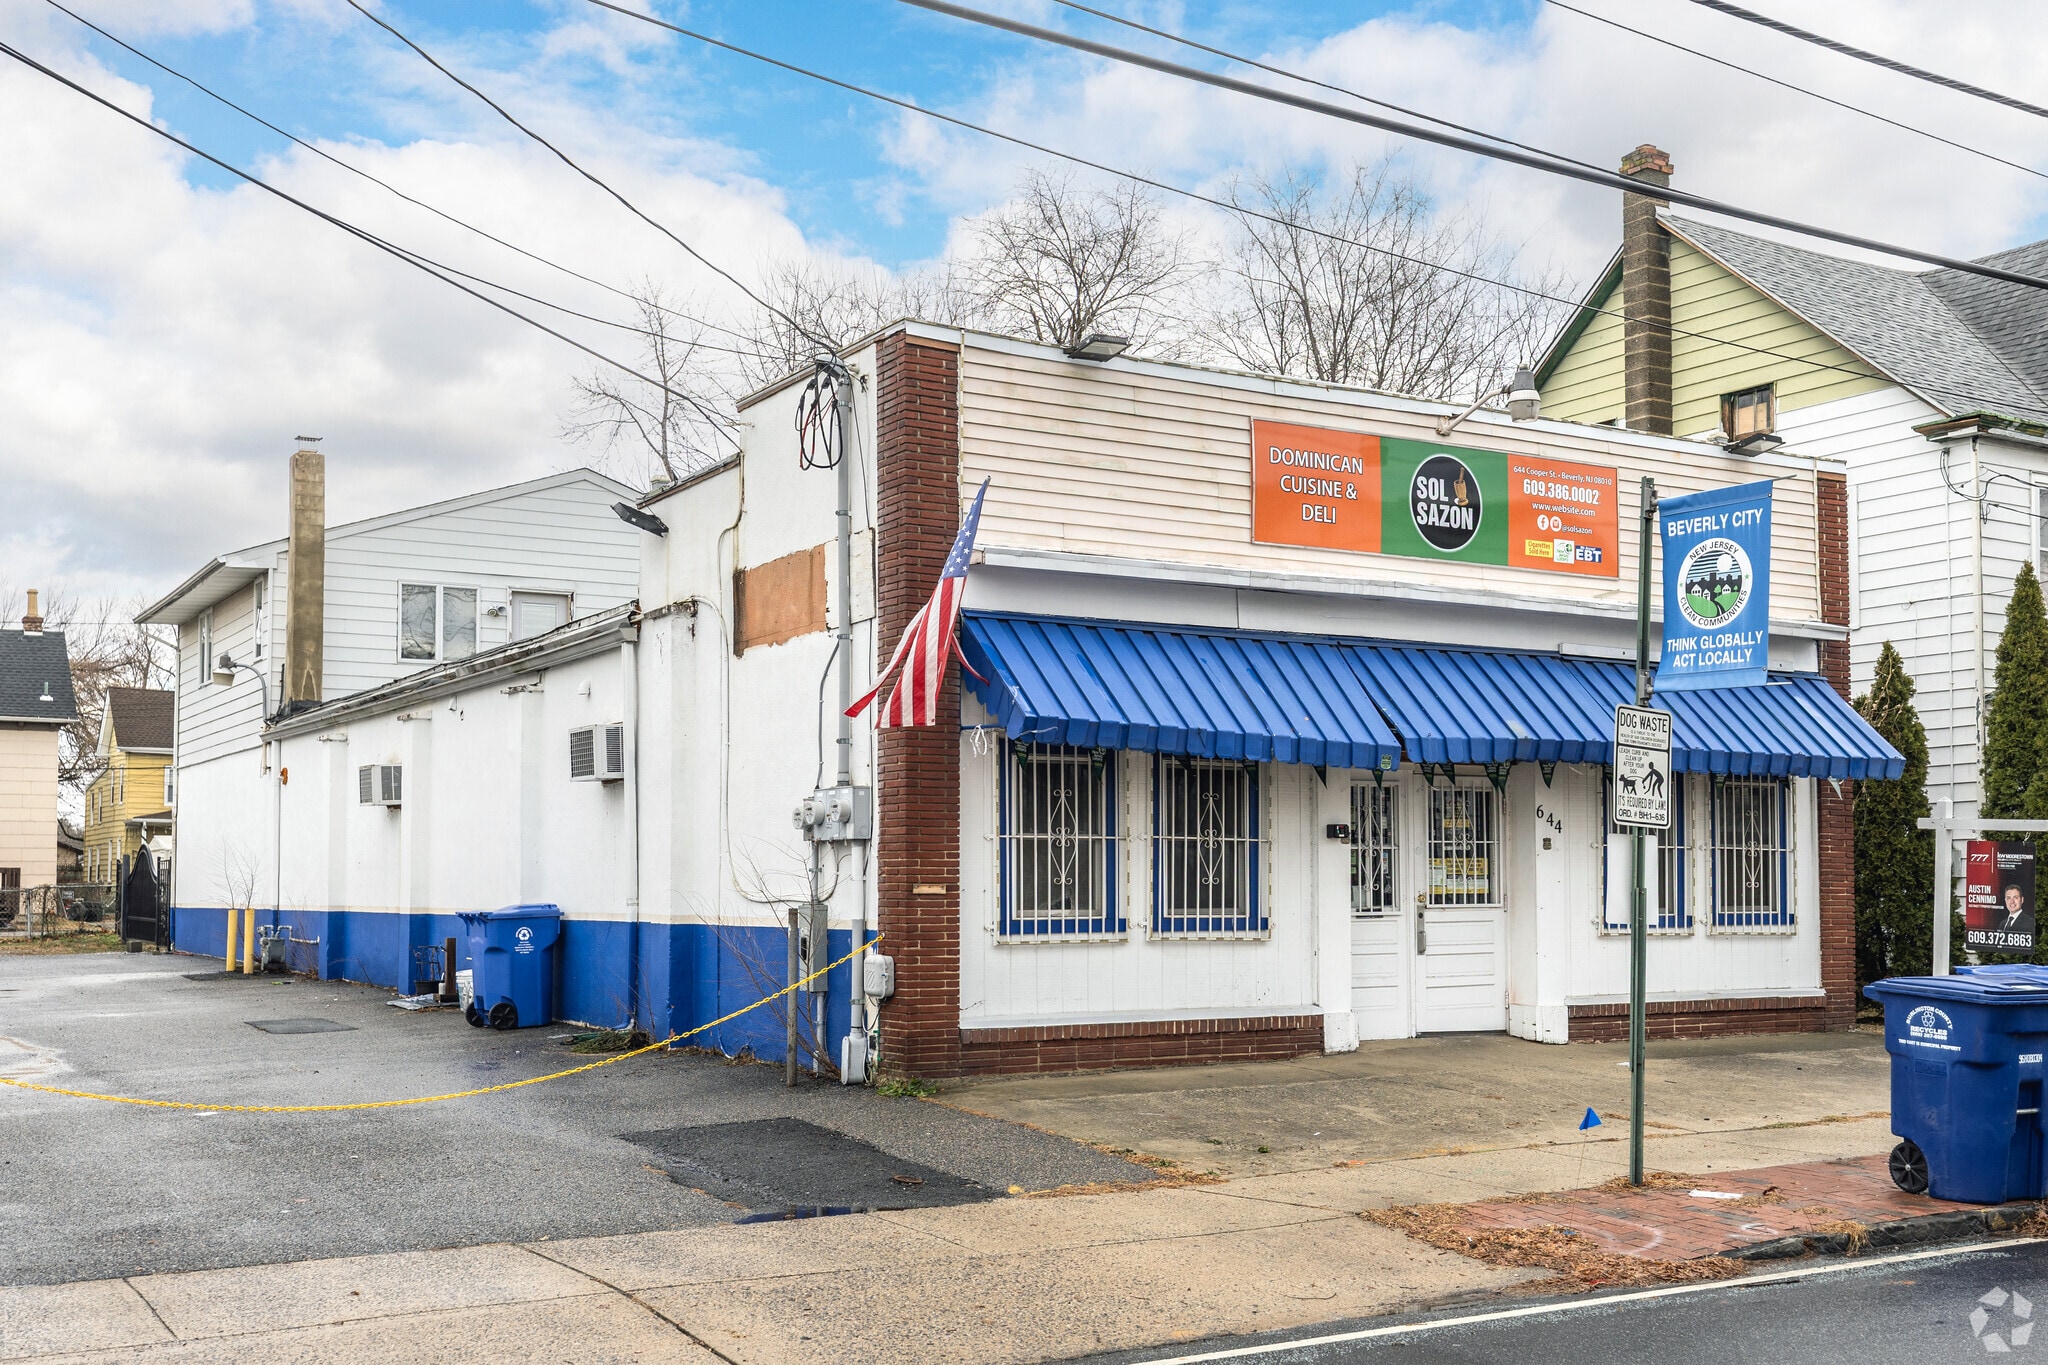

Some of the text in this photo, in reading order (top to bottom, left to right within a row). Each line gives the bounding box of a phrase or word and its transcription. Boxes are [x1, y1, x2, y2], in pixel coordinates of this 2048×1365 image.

[1269, 446, 1364, 475] DOMINICAN
[1513, 465, 1525, 474] 644
[1526, 467, 1548, 478] Cooper
[1586, 475, 1593, 483] NJ
[1279, 474, 1358, 500] CUISINE &
[1416, 475, 1449, 502] SOL
[1523, 478, 1599, 505] 609.386.0002
[1301, 503, 1337, 524] DELI
[1416, 502, 1474, 531] SAZON
[1532, 502, 1596, 517] www.website.com
[1561, 524, 1593, 535] @solsazon
[1667, 507, 1764, 537] BEVERLY CITY
[1575, 548, 1602, 562] EBT
[1689, 540, 1740, 562] NEW JERSEY
[1680, 590, 1748, 627] CLEAN COMMUNITIES
[1666, 630, 1764, 653] THINK GLOBALLY
[1672, 648, 1753, 668] ACT LOCALLY
[1620, 712, 1668, 733] DOG WASTE
[1618, 808, 1632, 818] ORD.
[1627, 796, 1647, 809] REQUIRED
[1648, 798, 1655, 809] BY
[1536, 804, 1562, 834] 644
[1970, 853, 1989, 862] 777
[1968, 884, 1991, 894] AUSTIN
[1968, 894, 1997, 904] CENNIMO
[1968, 931, 2032, 947] 609.372.6863
[1905, 1005, 1953, 1030] BURLINGTON COUNTY
[1910, 1025, 1948, 1036] RECYCLES
